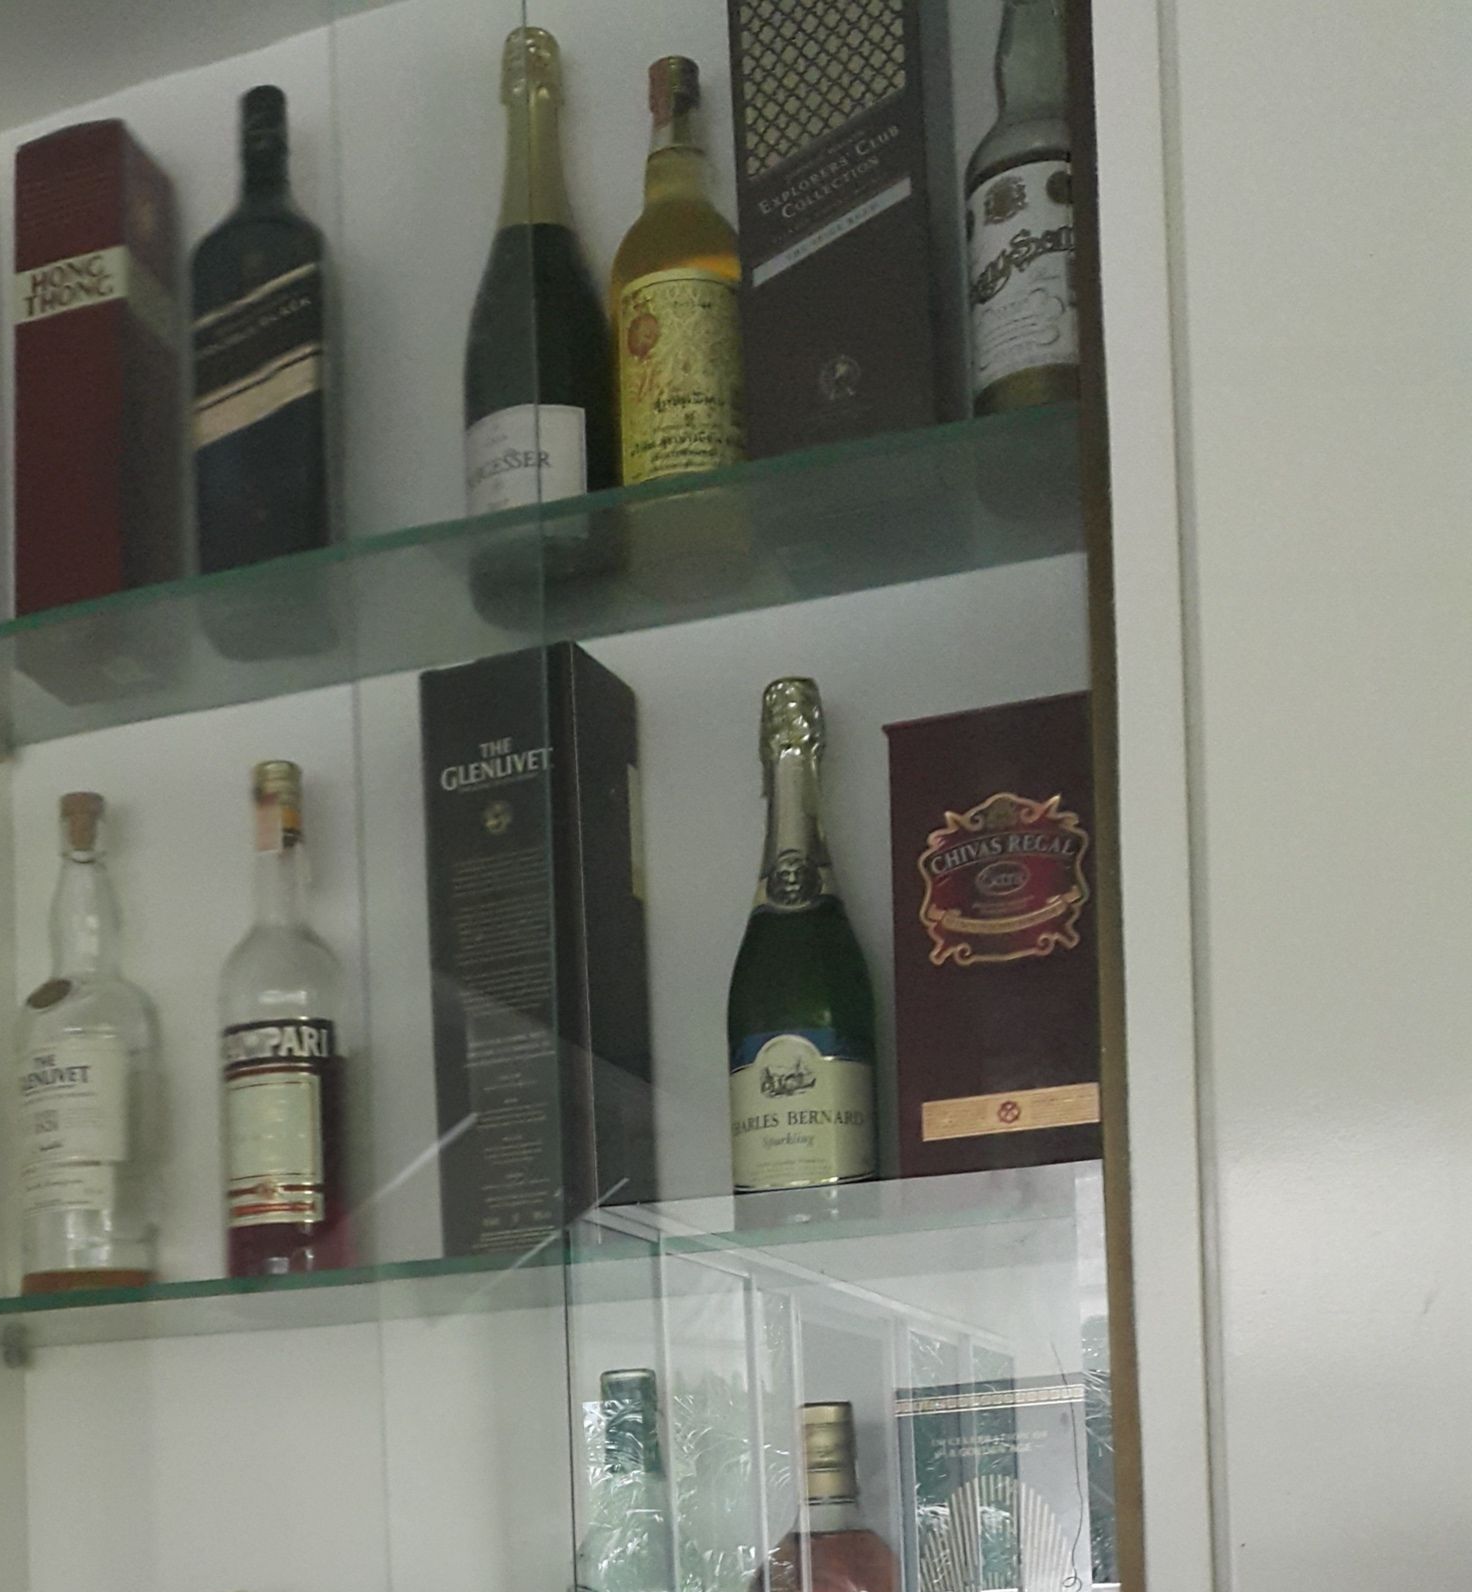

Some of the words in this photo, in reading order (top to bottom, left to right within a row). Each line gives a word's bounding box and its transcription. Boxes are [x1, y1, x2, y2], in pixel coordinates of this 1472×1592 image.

[24, 274, 113, 316] THONG
[32, 255, 103, 296] HONG
[478, 737, 512, 759] THE
[440, 747, 554, 792] GLENLIVET
[931, 836, 1002, 875] CHIVAS
[1008, 834, 1075, 856] REGAL
[787, 1109, 865, 1127] BERNARD
